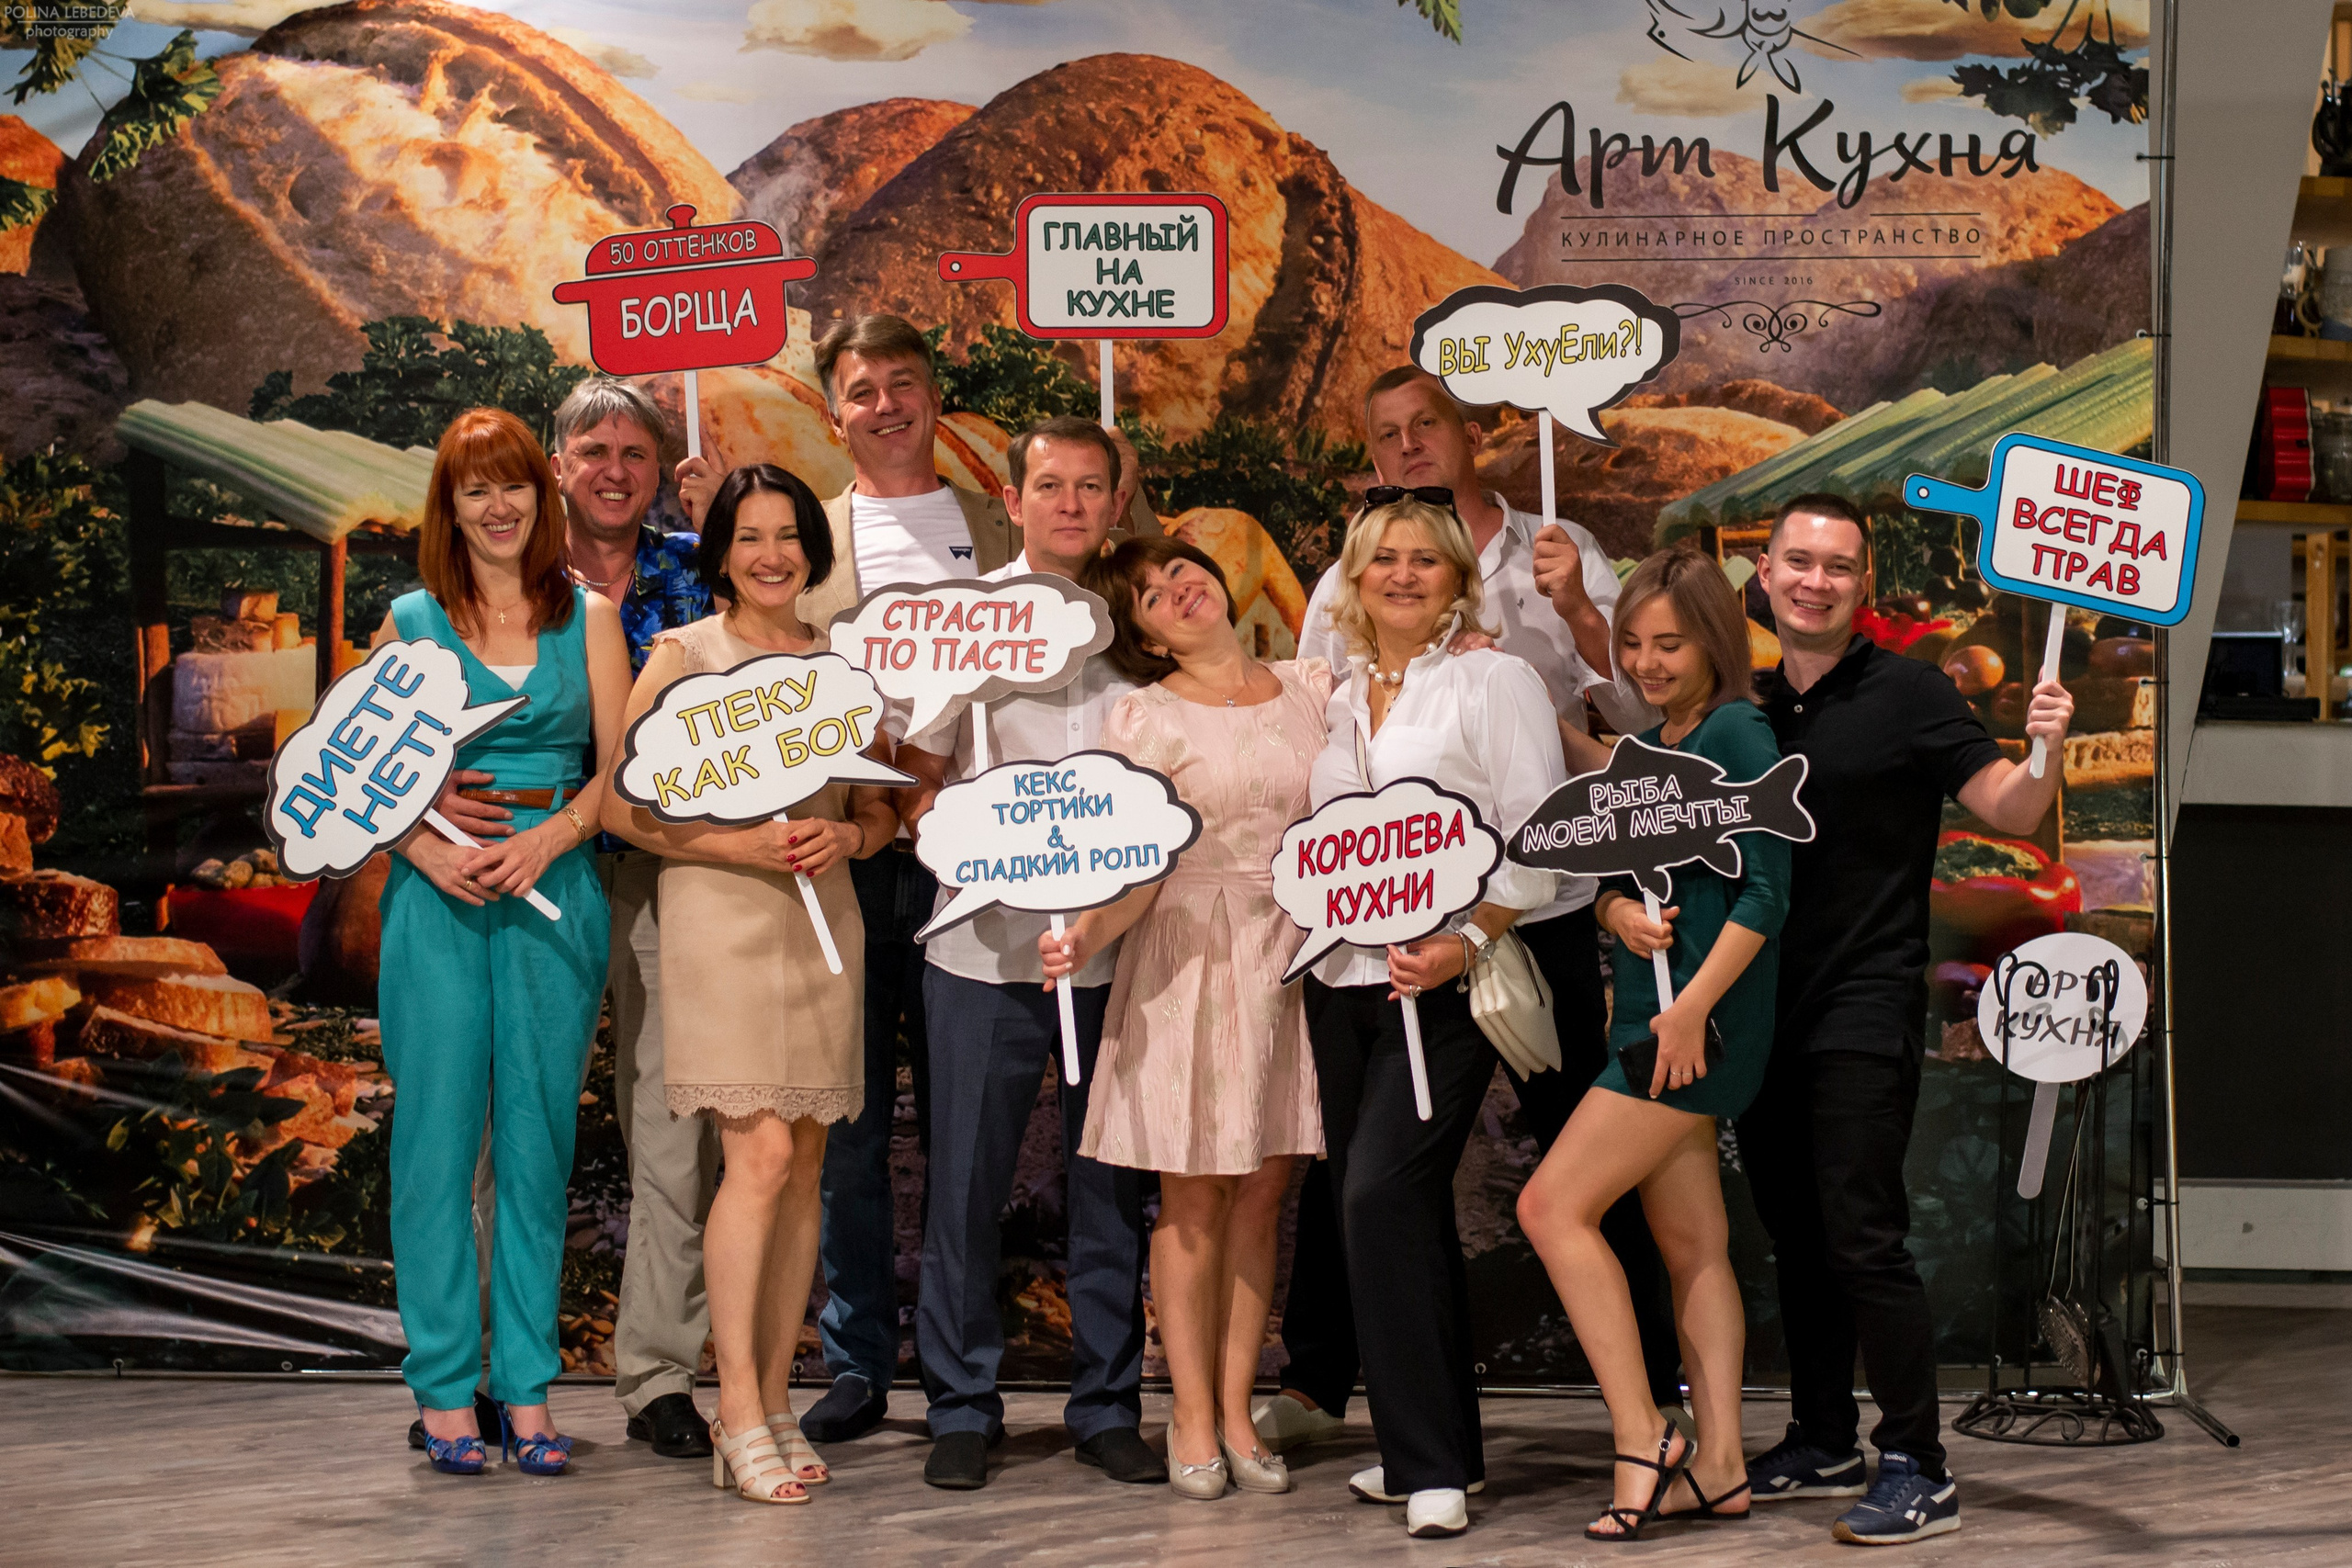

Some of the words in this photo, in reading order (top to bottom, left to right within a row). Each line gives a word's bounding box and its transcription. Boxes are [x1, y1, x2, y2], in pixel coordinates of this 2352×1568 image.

[1496, 100, 1715, 215] Арт
[1762, 93, 2041, 209] Кухня
[610, 242, 635, 265] 50
[644, 229, 757, 261] ОТТЕНКОВ
[1044, 214, 1198, 252] ГЛАВНЫЙ
[1562, 230, 1745, 248] КУЛИНАРНОЕ
[1764, 228, 1982, 246] ПРОСТРАНСТВО
[1096, 257, 1143, 285] НА
[1735, 276, 1774, 285] SINCE
[1784, 276, 1813, 285] 2016
[620, 288, 758, 339] БОРЩА
[1067, 289, 1175, 318] КУХНЕ
[1440, 336, 1490, 377] ВЫ
[1504, 317, 1642, 378] УхуЕли?!
[2054, 464, 2142, 511] ШЕФ
[2013, 497, 2166, 560] ВСЕГДА
[2031, 543, 2140, 594] ПРАВ
[882, 599, 1034, 634] СТРАСТИ
[863, 637, 917, 671] ПО
[932, 638, 1047, 673] ПАСТЕ
[676, 670, 817, 747] ПЕКУ
[280, 655, 424, 839] ДИЕТЕ
[653, 744, 760, 807] КАК
[775, 705, 872, 768] БОГ
[343, 710, 452, 834] НЕТ!
[1014, 770, 1085, 796] КЕКС,
[1589, 774, 1682, 811] РЫБА
[992, 793, 1113, 825] ТОРТИКИ
[1522, 807, 1617, 853] МОЕЙ
[1629, 795, 1751, 839] МЕЧТЫ
[1047, 825, 1066, 849] &
[1297, 808, 1466, 879] КОРОЛЕВА
[956, 844, 1080, 883] СЛАДКИЙ
[1090, 843, 1159, 872] РОЛЛ
[1326, 868, 1434, 928] КУХНИ
